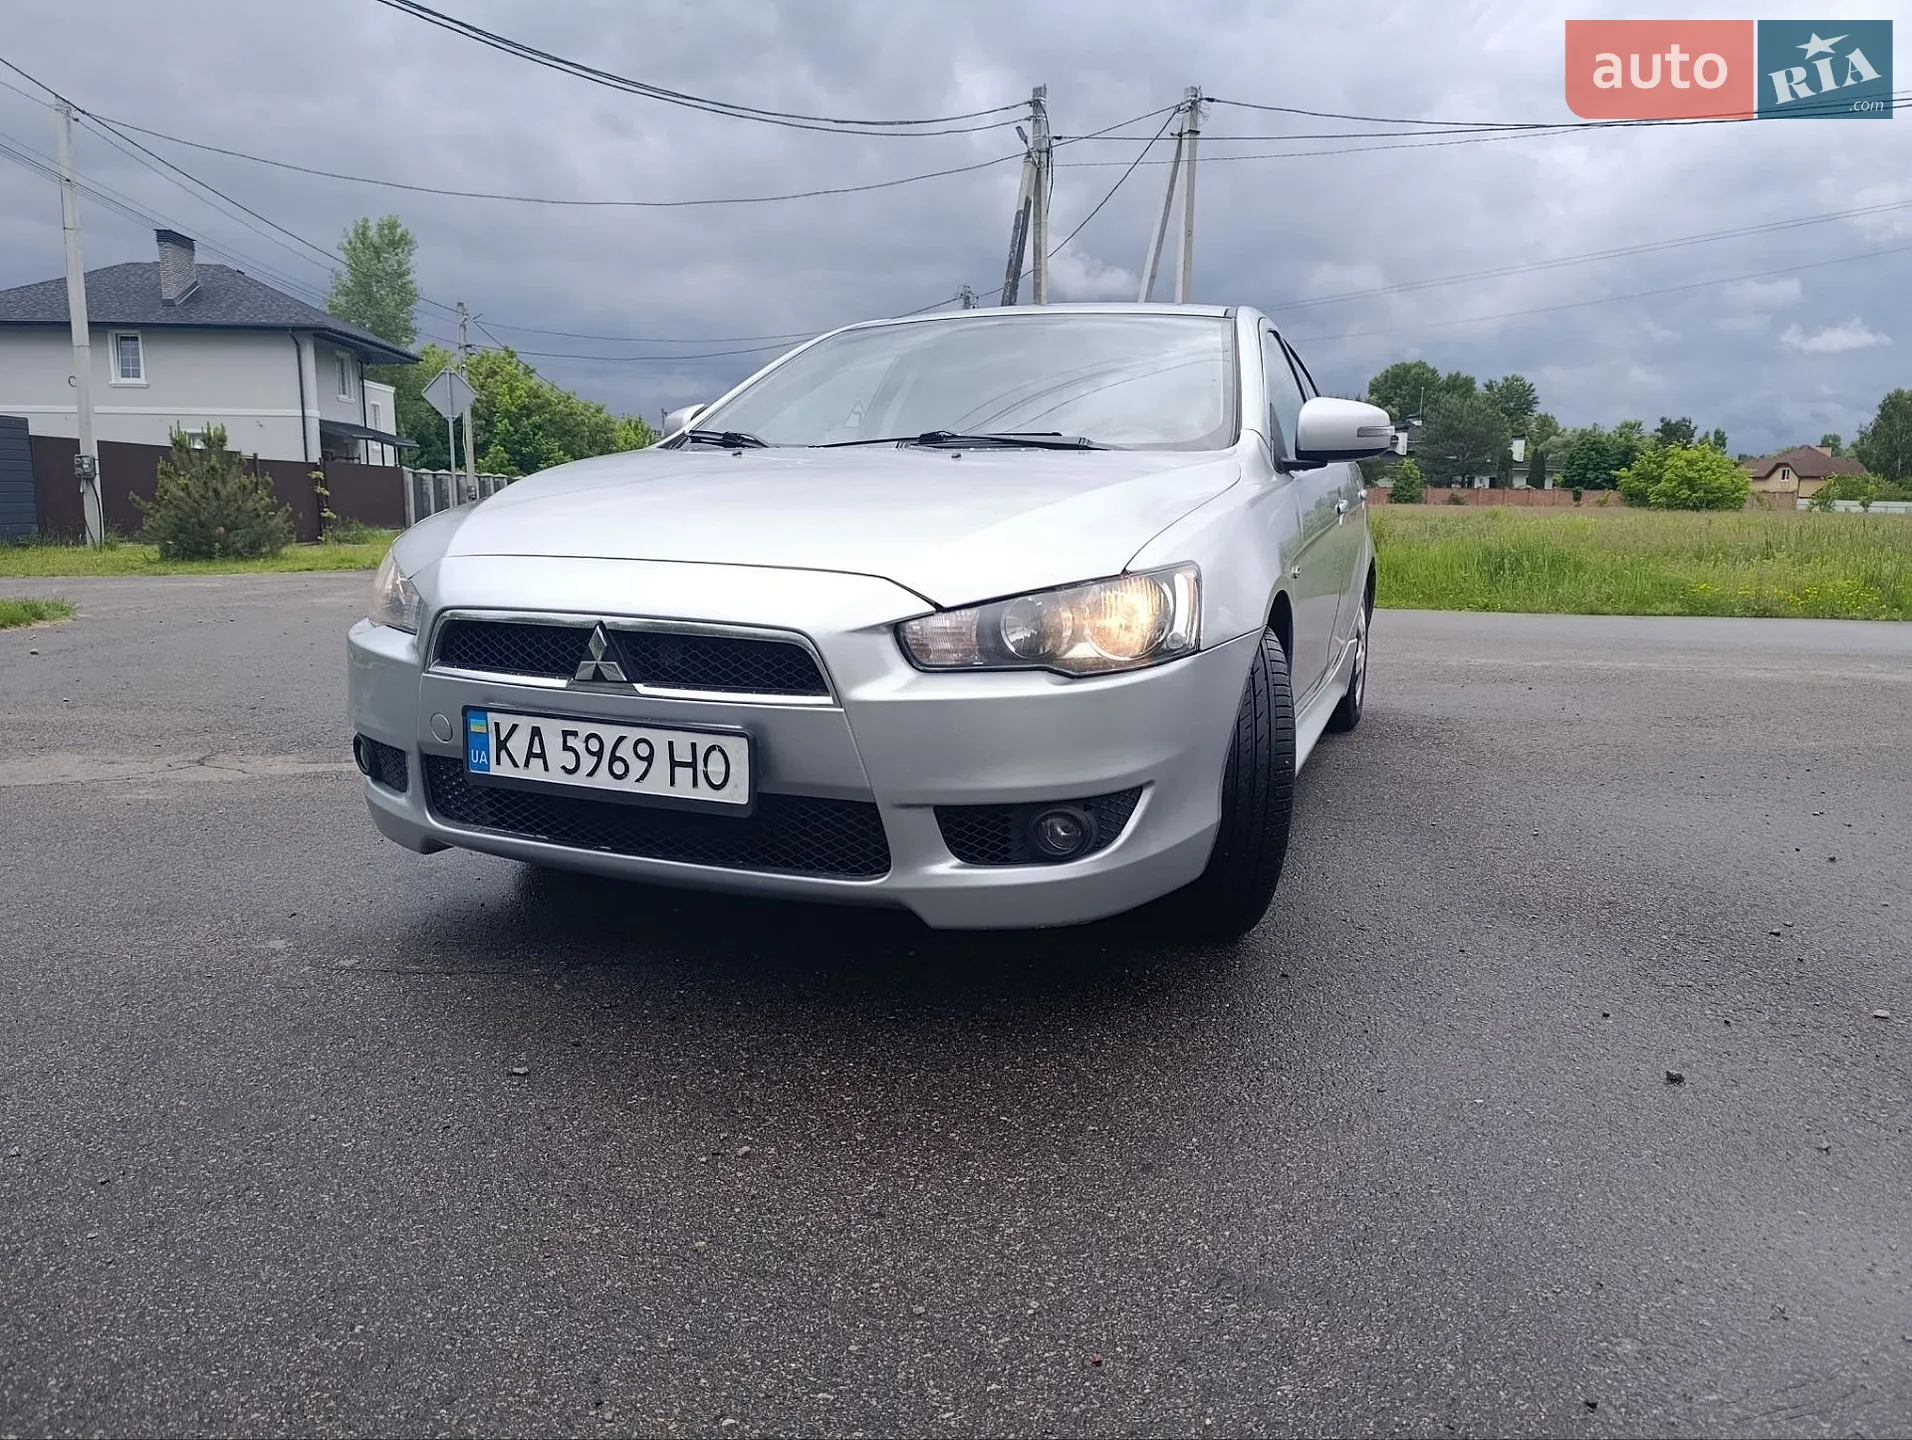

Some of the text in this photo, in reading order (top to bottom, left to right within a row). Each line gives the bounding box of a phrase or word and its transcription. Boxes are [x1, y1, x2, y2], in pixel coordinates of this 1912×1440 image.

[471, 749, 488, 765] UA
[493, 721, 730, 791] KA 5969 HO
